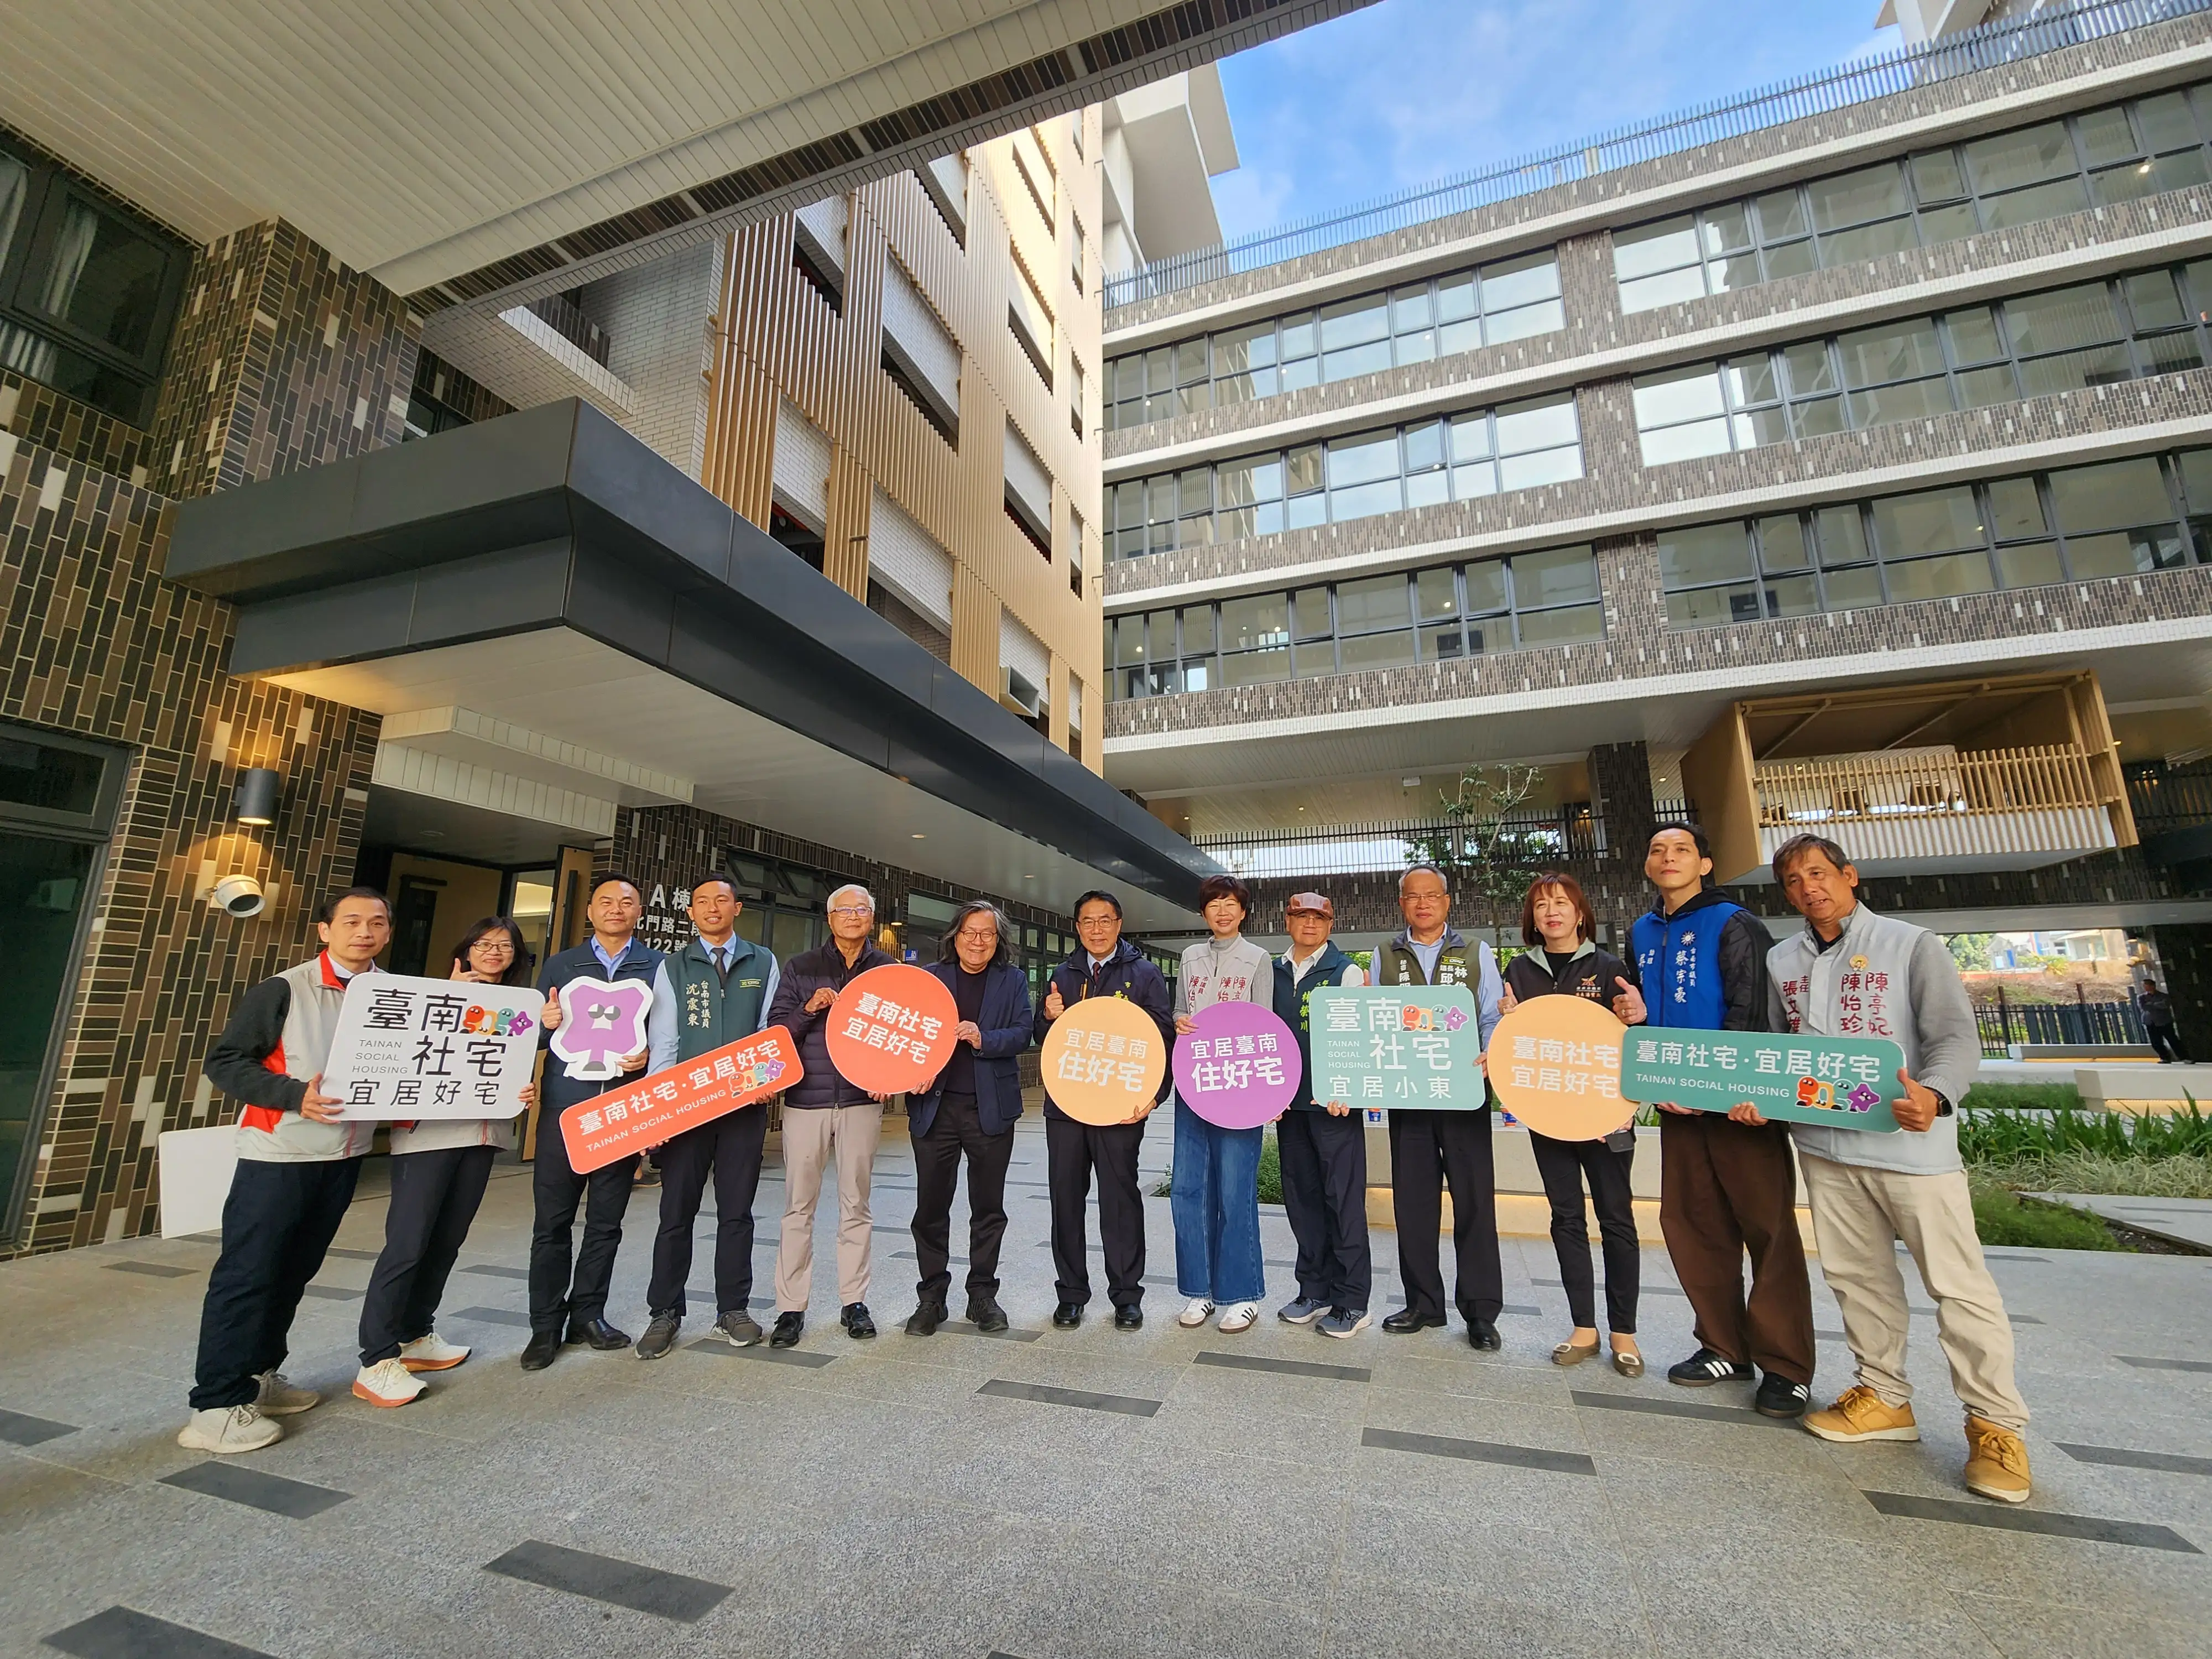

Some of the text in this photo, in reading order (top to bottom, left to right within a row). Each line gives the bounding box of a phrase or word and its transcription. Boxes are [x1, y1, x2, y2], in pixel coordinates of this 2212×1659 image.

[1674, 950, 1689, 1003] 蔡宗豪
[363, 988, 468, 1034] 臺南
[685, 983, 700, 1026] 沈震東
[854, 991, 943, 1041] 臺南社宅
[1326, 997, 1401, 1032] 臺南
[1840, 972, 1864, 1034] 陳怡珍
[1865, 971, 1893, 1036] 陳亭妃
[355, 1052, 399, 1061] SOCIAL
[359, 1040, 402, 1048] TAINAN
[411, 1035, 507, 1077] 社宅
[842, 1016, 931, 1065] 宜居好宅
[1064, 1028, 1149, 1059] 宜居臺南
[1191, 1032, 1278, 1060] 宜居臺南
[1370, 1034, 1452, 1071] 社宅
[1511, 1035, 1619, 1070] 臺南社宅
[352, 1065, 408, 1074] HOUSING
[1057, 1050, 1146, 1093] 住好宅
[1191, 1056, 1286, 1093] 住好宅
[1329, 1076, 1452, 1099] 宜居小東
[1510, 1065, 1619, 1099] 宜居好宅
[1636, 1073, 1790, 1098] TAINAN SOCIAL HOUSING
[346, 1078, 500, 1106] 宜居好宅
[586, 1090, 727, 1152] TAINAN SOCIAL HOUSING
